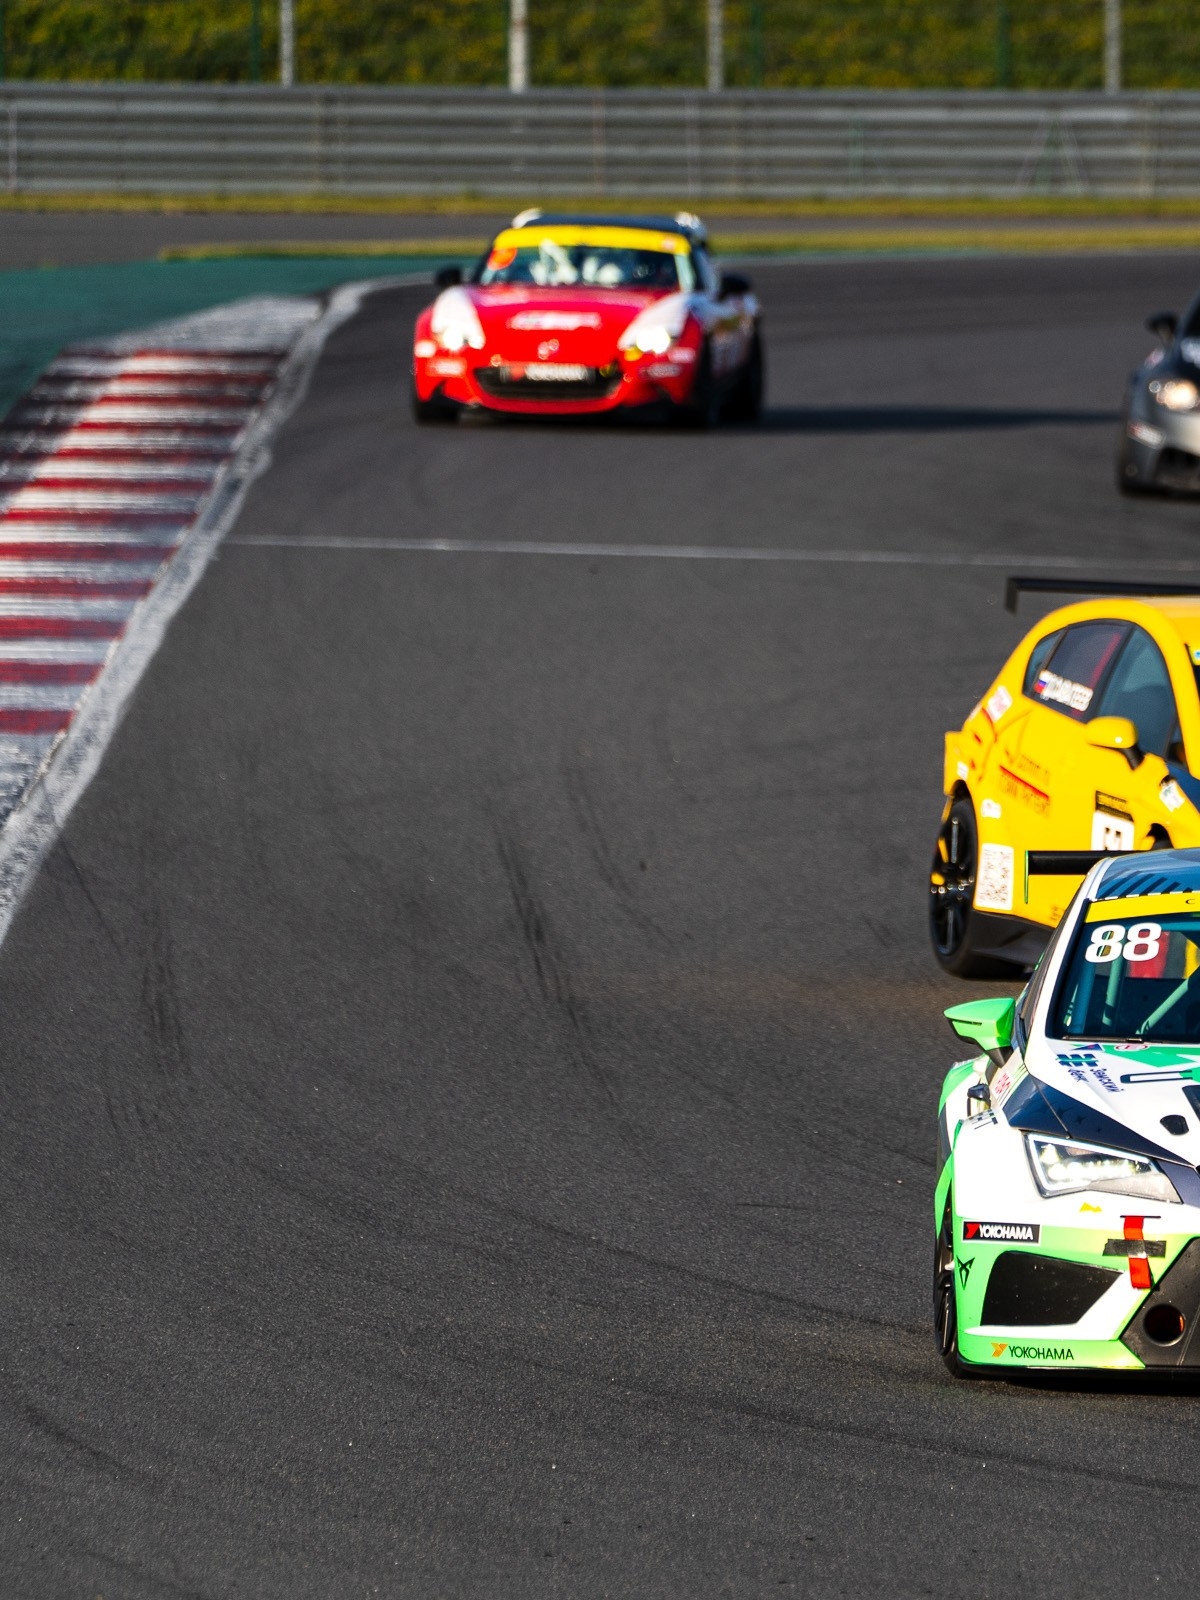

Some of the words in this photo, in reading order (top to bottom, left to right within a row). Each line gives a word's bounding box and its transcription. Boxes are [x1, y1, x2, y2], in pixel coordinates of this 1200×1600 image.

[1085, 922, 1162, 963] 88
[979, 1224, 1034, 1240] YOKOHAMA
[1008, 1345, 1075, 1361] YOKOHAMA
